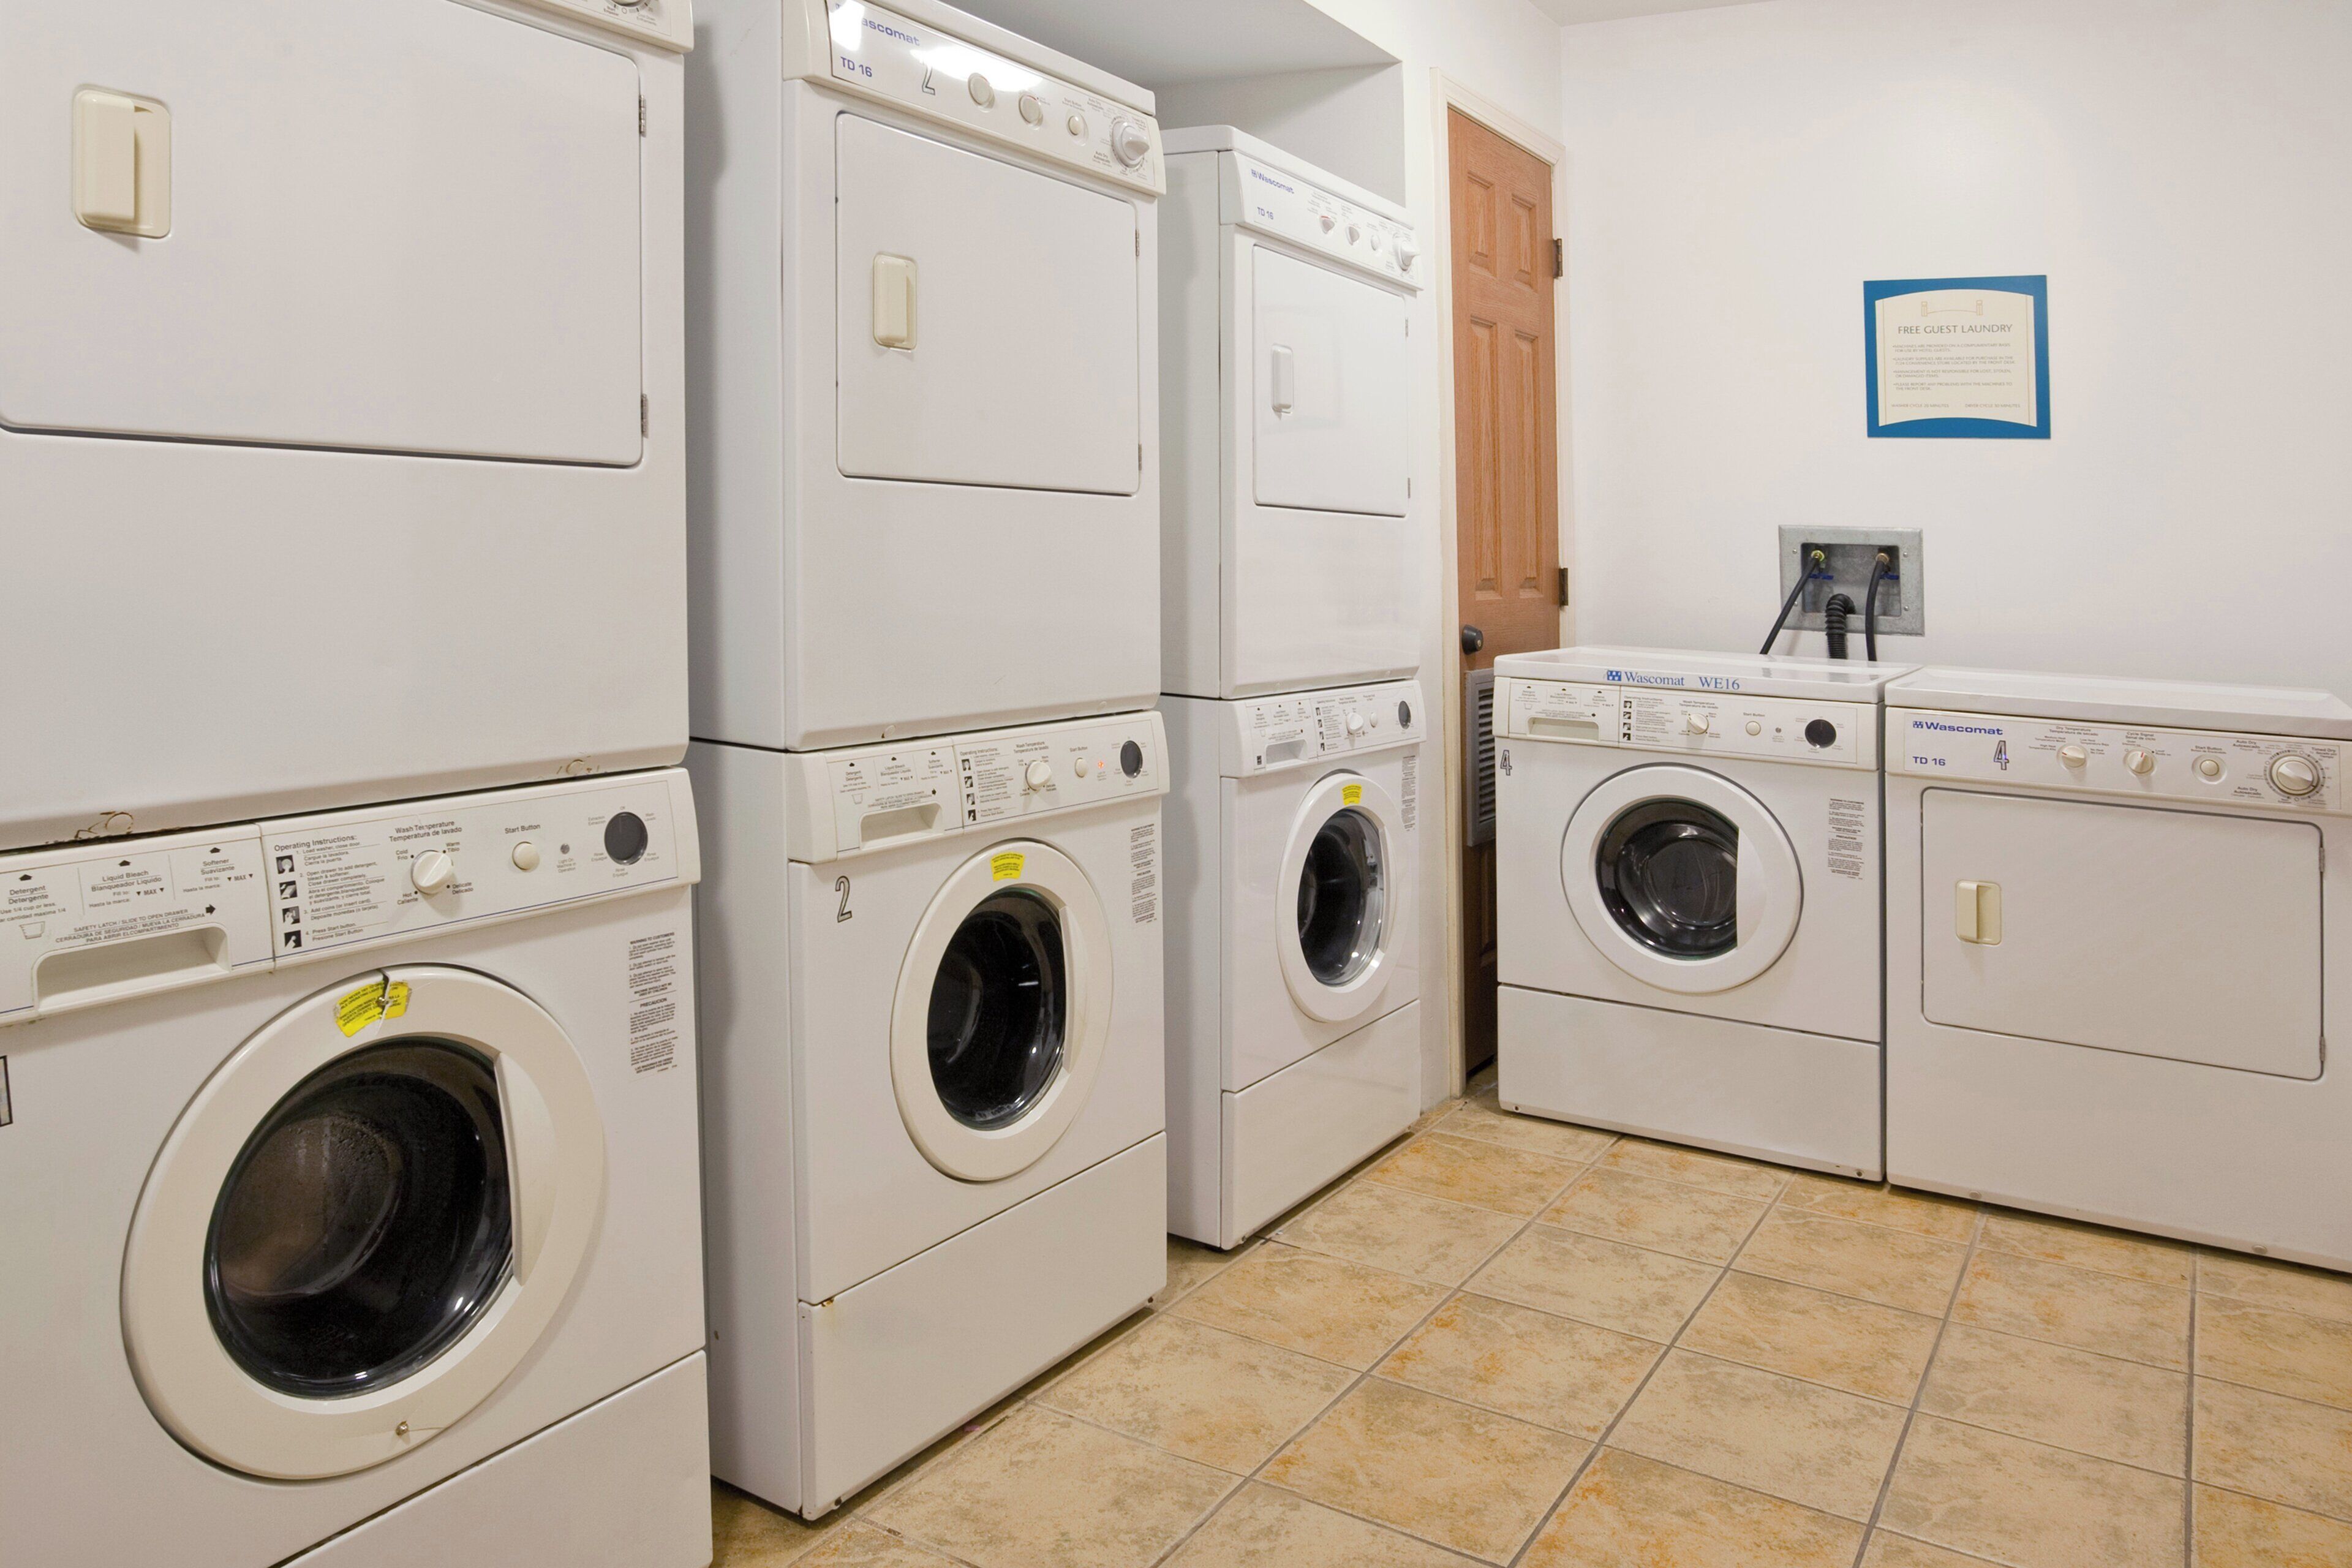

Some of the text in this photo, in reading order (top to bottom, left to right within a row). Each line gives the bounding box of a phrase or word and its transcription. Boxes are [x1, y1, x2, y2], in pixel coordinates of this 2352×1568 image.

[862, 17, 920, 46] ascomat
[840, 56, 873, 77] TD 16
[1257, 206, 1273, 220] TD 16
[1898, 324, 2013, 334] FREE GUEST LAUNDRY
[1624, 671, 1740, 690] Wascomat WE16
[1925, 722, 2003, 735] Wascomat
[1913, 756, 1928, 764] TD
[1993, 740, 2009, 771] 4
[1500, 749, 1512, 776] 4
[415, 821, 455, 831] Temperature
[505, 823, 541, 834] Start Button
[390, 832, 430, 842] Temperatura
[274, 835, 357, 852] Operating Instructions:
[201, 866, 235, 875] Suavizante
[102, 873, 124, 882] Liquid
[9, 885, 46, 895] Detergent
[91, 881, 135, 892] Blanqueador
[9, 894, 49, 905] Detergente
[835, 875, 853, 923] 2
[56, 932, 94, 943] CERRADURA
[104, 924, 138, 934] SEGURIDAD
[172, 913, 206, 922] CERRADURA
[74, 924, 96, 932] SAFETY
